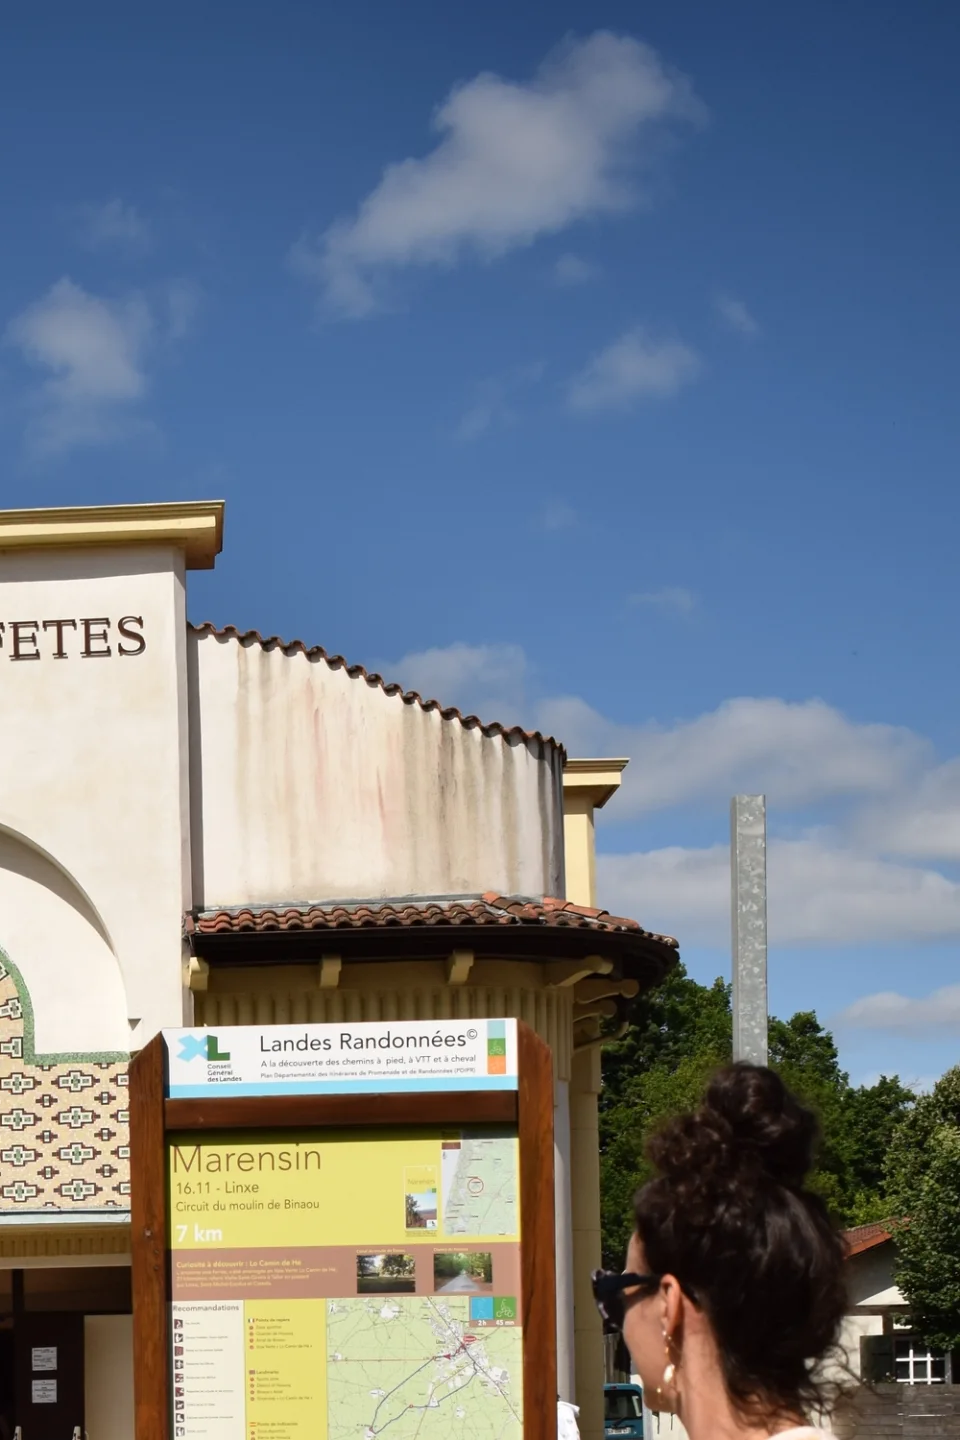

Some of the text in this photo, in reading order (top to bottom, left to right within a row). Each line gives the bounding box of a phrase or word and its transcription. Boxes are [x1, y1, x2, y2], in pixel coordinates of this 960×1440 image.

[260, 1033, 332, 1053] Landes
[260, 1060, 268, 1068] A
[269, 1060, 277, 1068] la
[278, 1059, 323, 1068] découverte
[325, 1059, 340, 1067] des
[342, 1057, 374, 1066] chemins
[376, 1056, 382, 1065] à
[408, 1056, 414, 1064] à
[415, 1055, 431, 1063] VTT
[443, 1055, 449, 1063] à
[451, 1054, 476, 1063] cheval
[173, 1143, 321, 1173] Marensin
[176, 1182, 211, 1195] 16.11
[225, 1181, 259, 1194] Linxe
[175, 1199, 320, 1212] Circuit du moulin de Binaou
[176, 1222, 223, 1243] 7 km
[173, 1303, 240, 1312] Recommandations
